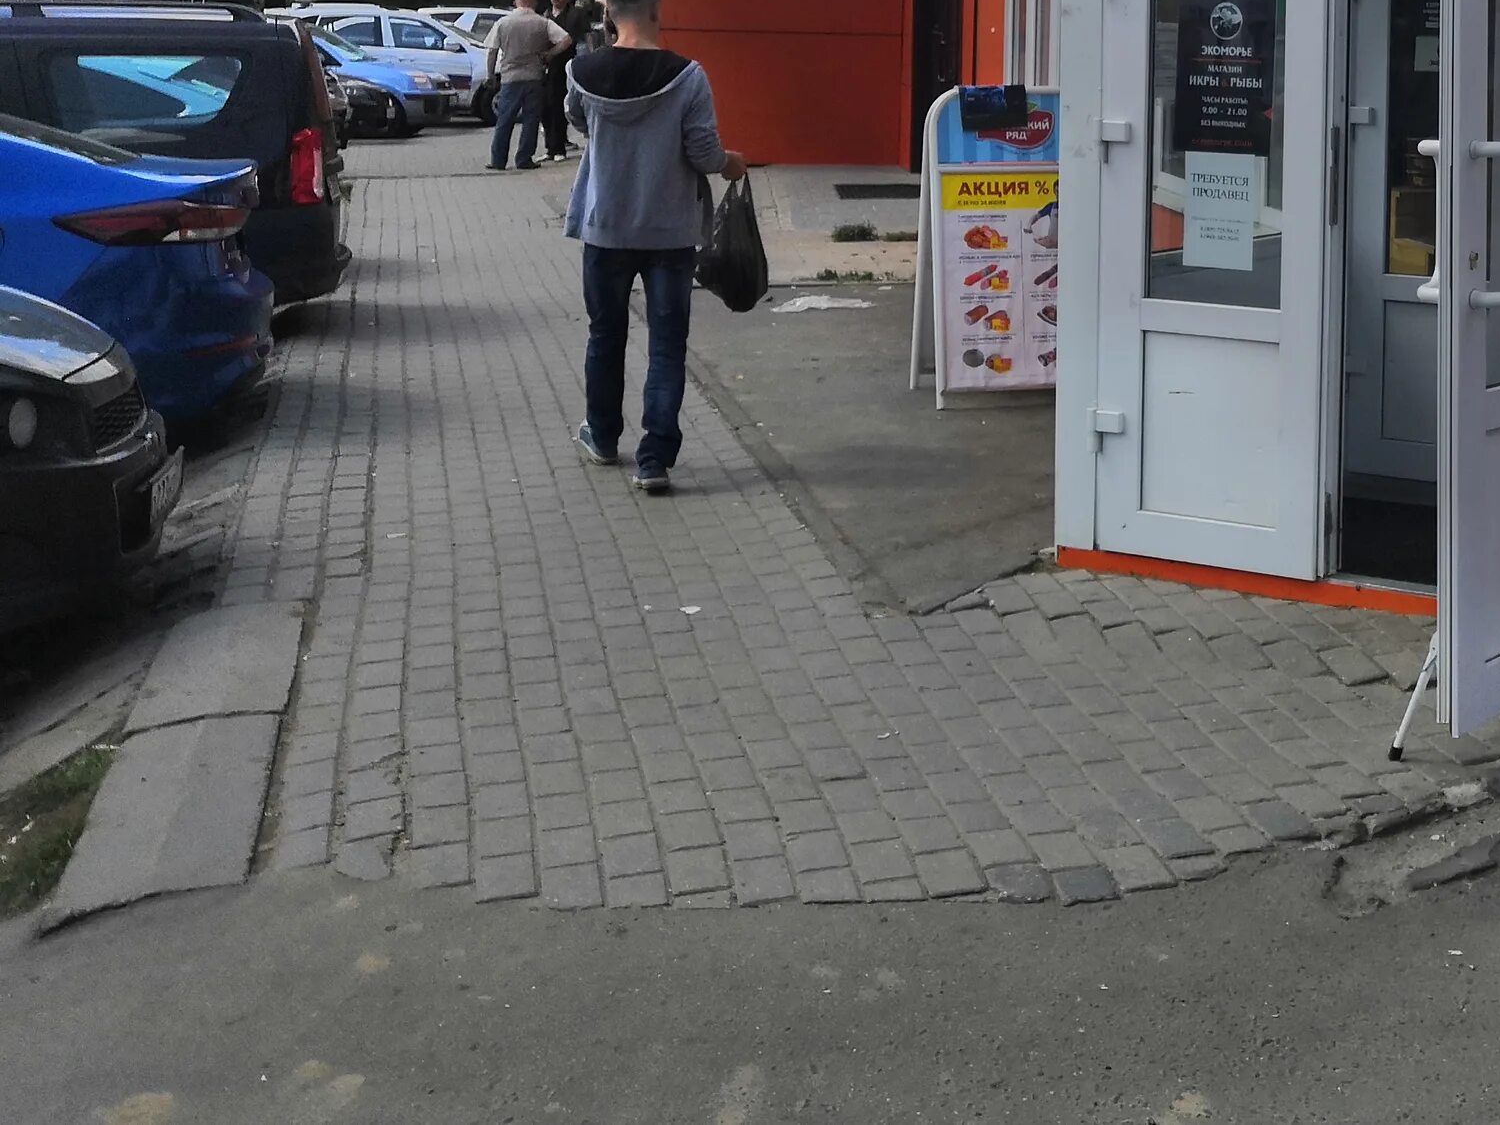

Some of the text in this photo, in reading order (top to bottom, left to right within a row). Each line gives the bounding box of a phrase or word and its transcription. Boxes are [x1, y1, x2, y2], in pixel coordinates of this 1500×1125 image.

[1201, 45, 1252, 57] ЭКОМОРЬЕ
[1207, 65, 1243, 73] МАГАЗИН
[1189, 75, 1219, 86] ИКРЫ
[1230, 77, 1263, 89] РЫБЫ
[1190, 172, 1249, 187] ТРЕБУЕТСЯ
[957, 181, 1030, 198] АКЦИЯ
[1191, 187, 1250, 202] ПРОДАВЕЦ
